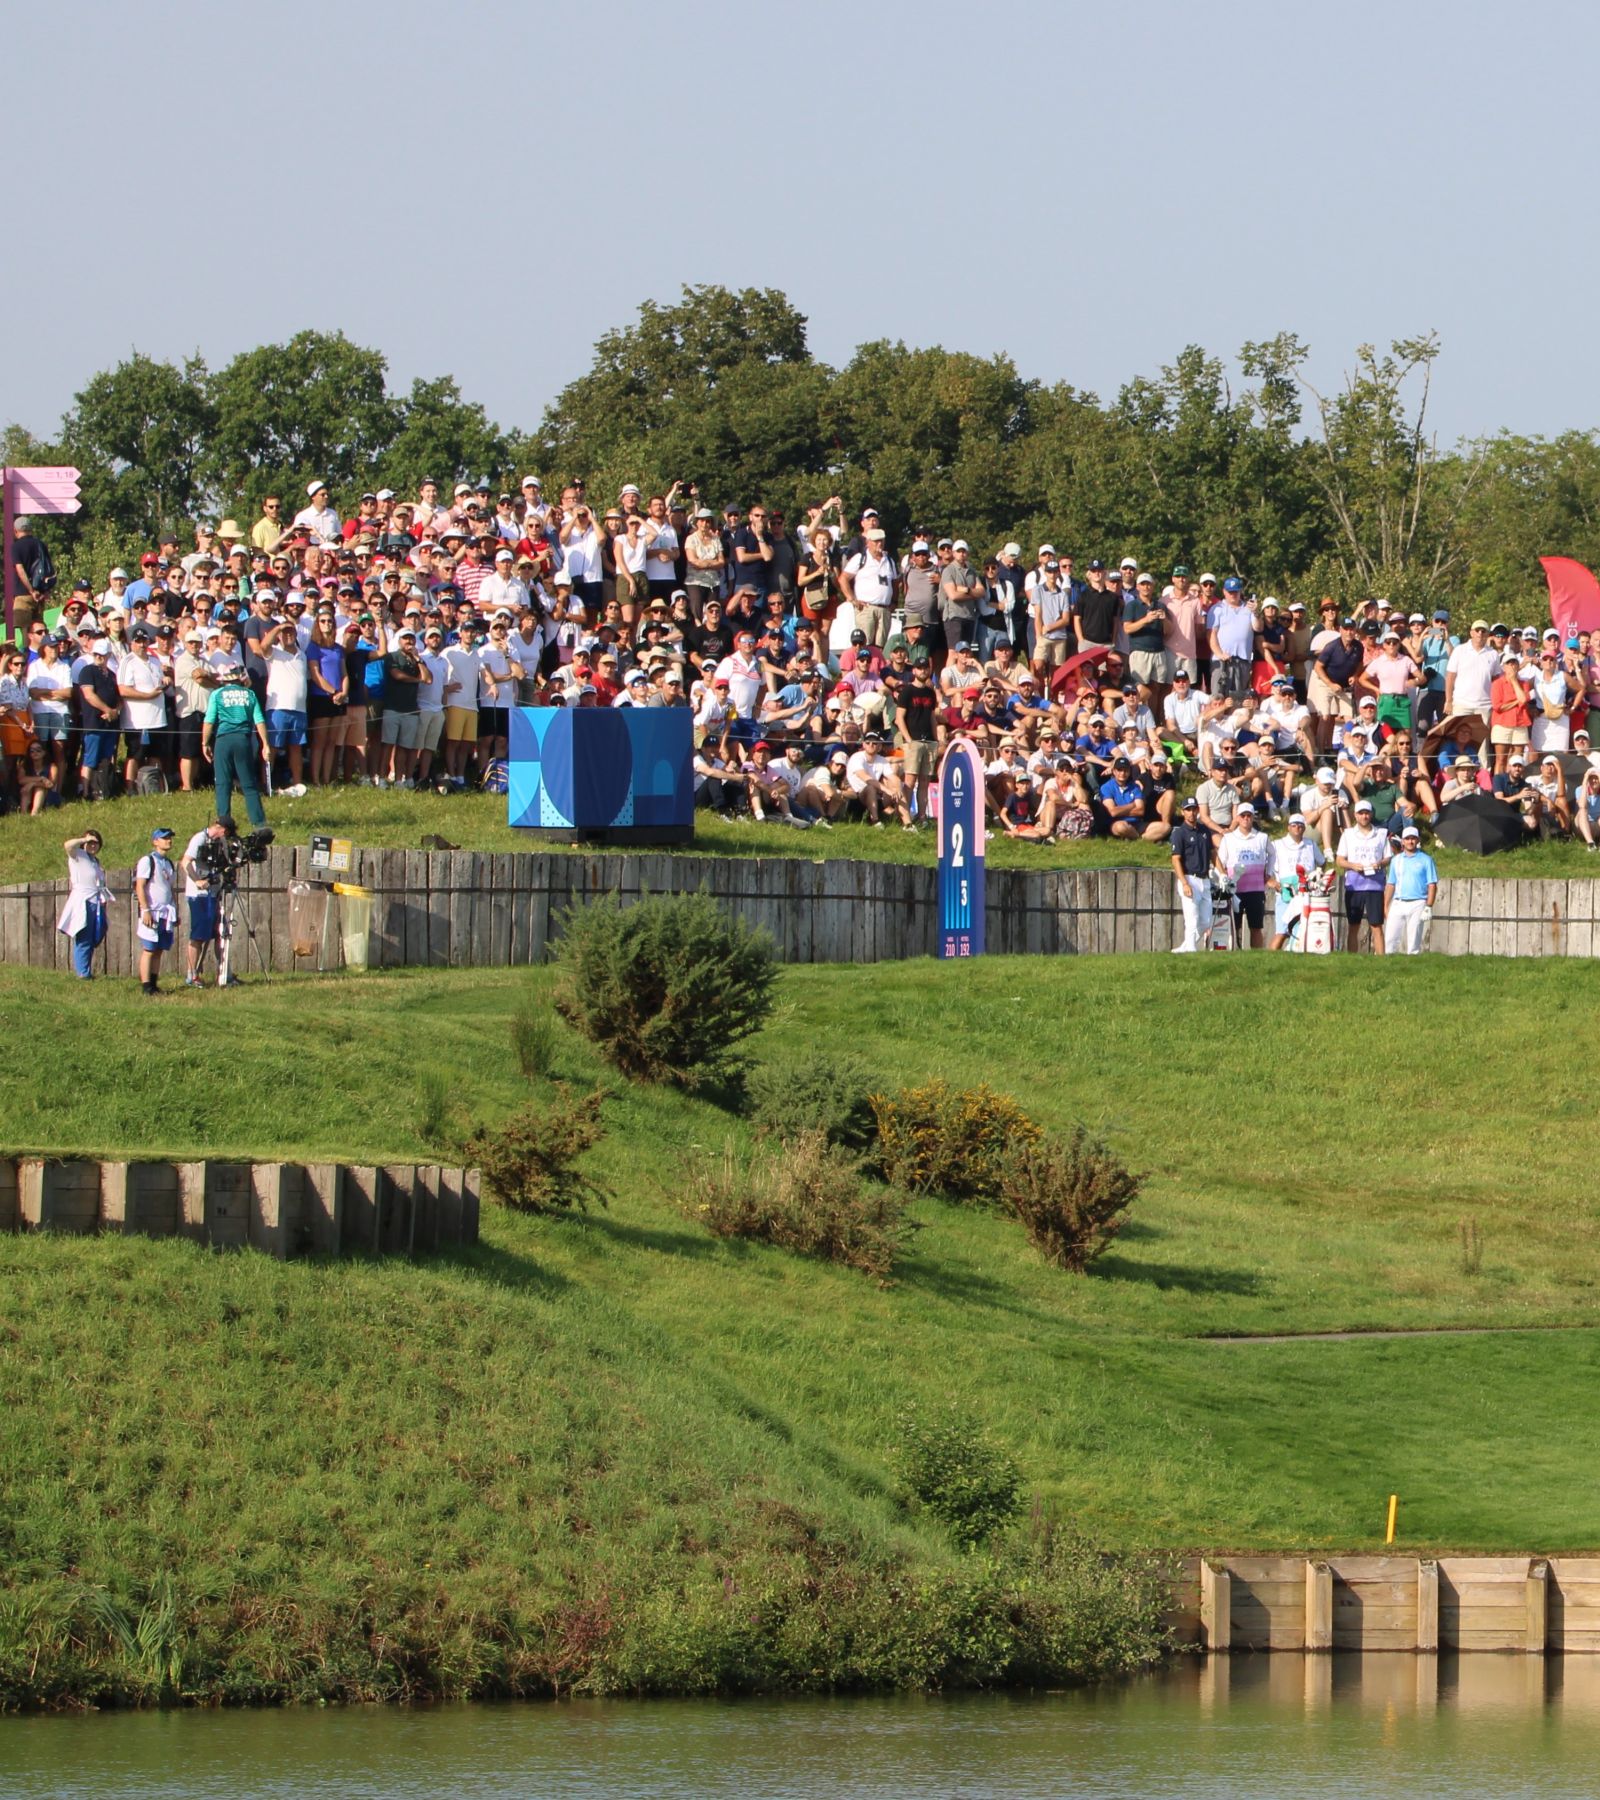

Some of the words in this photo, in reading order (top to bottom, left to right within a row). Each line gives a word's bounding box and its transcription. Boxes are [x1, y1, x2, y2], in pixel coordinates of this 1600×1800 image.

[222, 690, 249, 698] PARIS
[223, 698, 250, 708] 2024
[952, 823, 964, 868] 2
[961, 888, 968, 907] 3
[960, 943, 970, 956] 192
